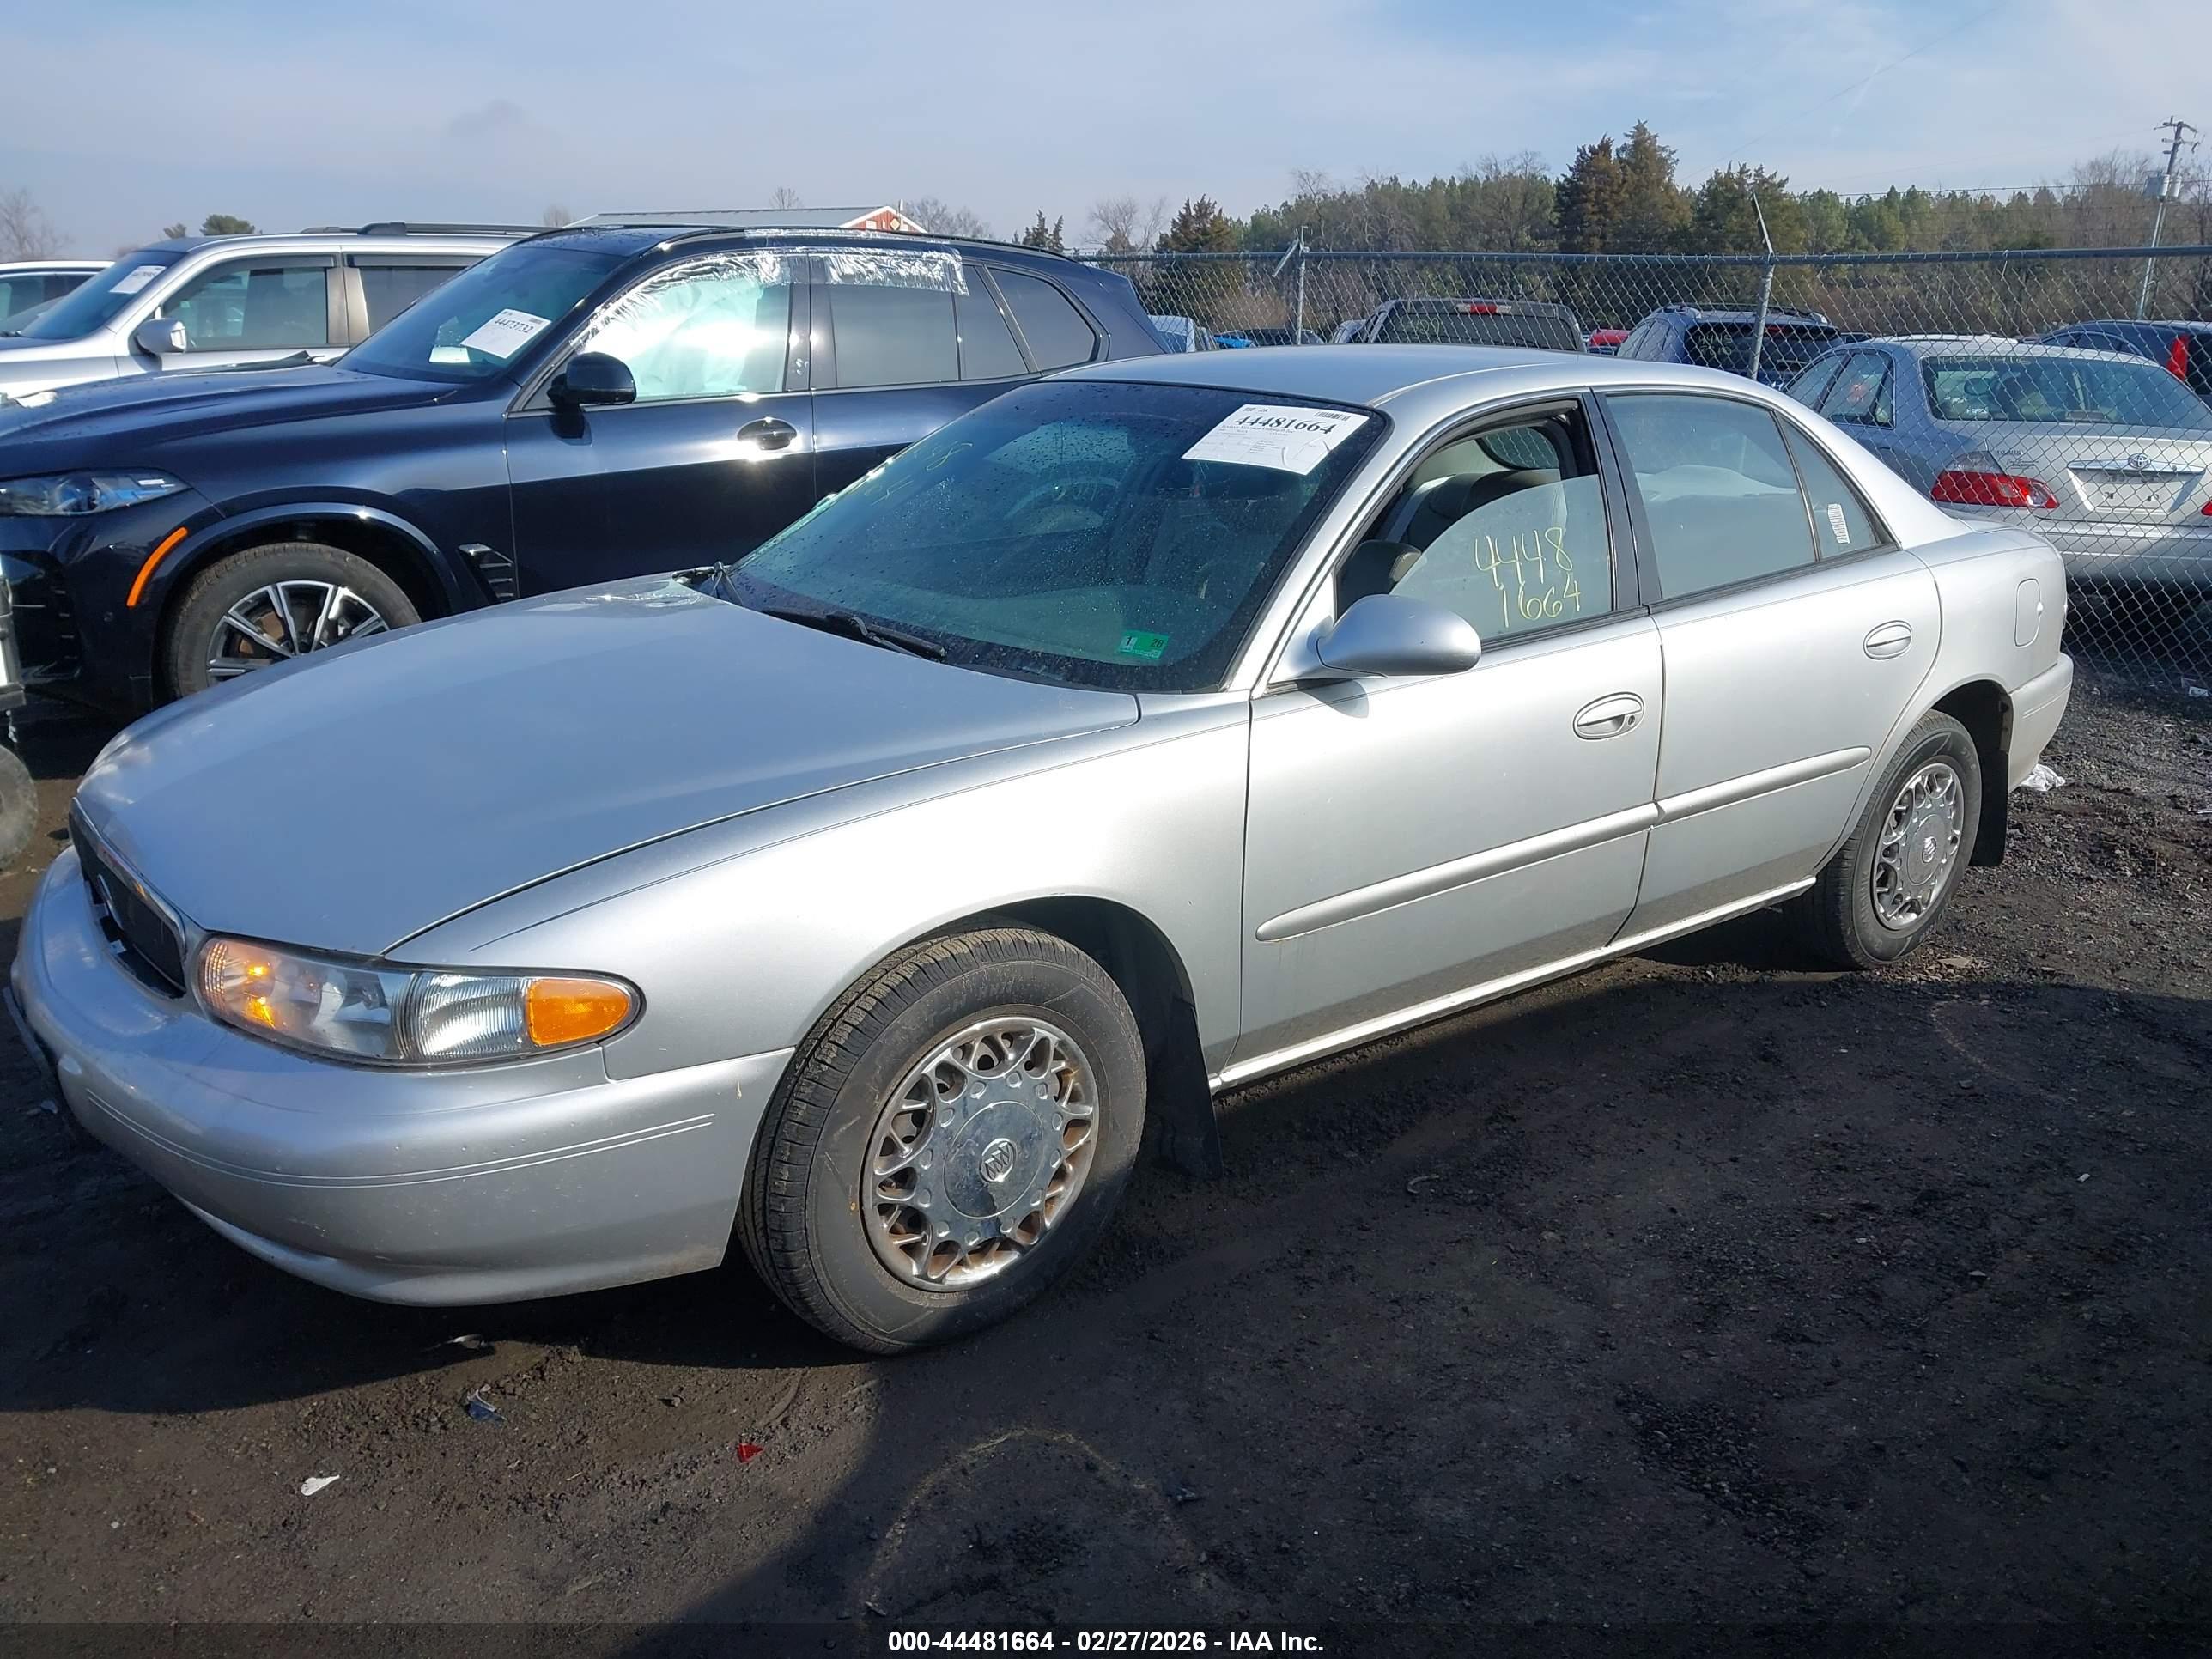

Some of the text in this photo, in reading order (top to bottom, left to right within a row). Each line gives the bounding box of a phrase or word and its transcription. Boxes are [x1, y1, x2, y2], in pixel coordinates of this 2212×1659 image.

[494, 318, 534, 333] 44473732
[1235, 415, 1337, 434] 44481664
[1475, 526, 1573, 587] 4448
[1499, 573, 1581, 628] 1664
